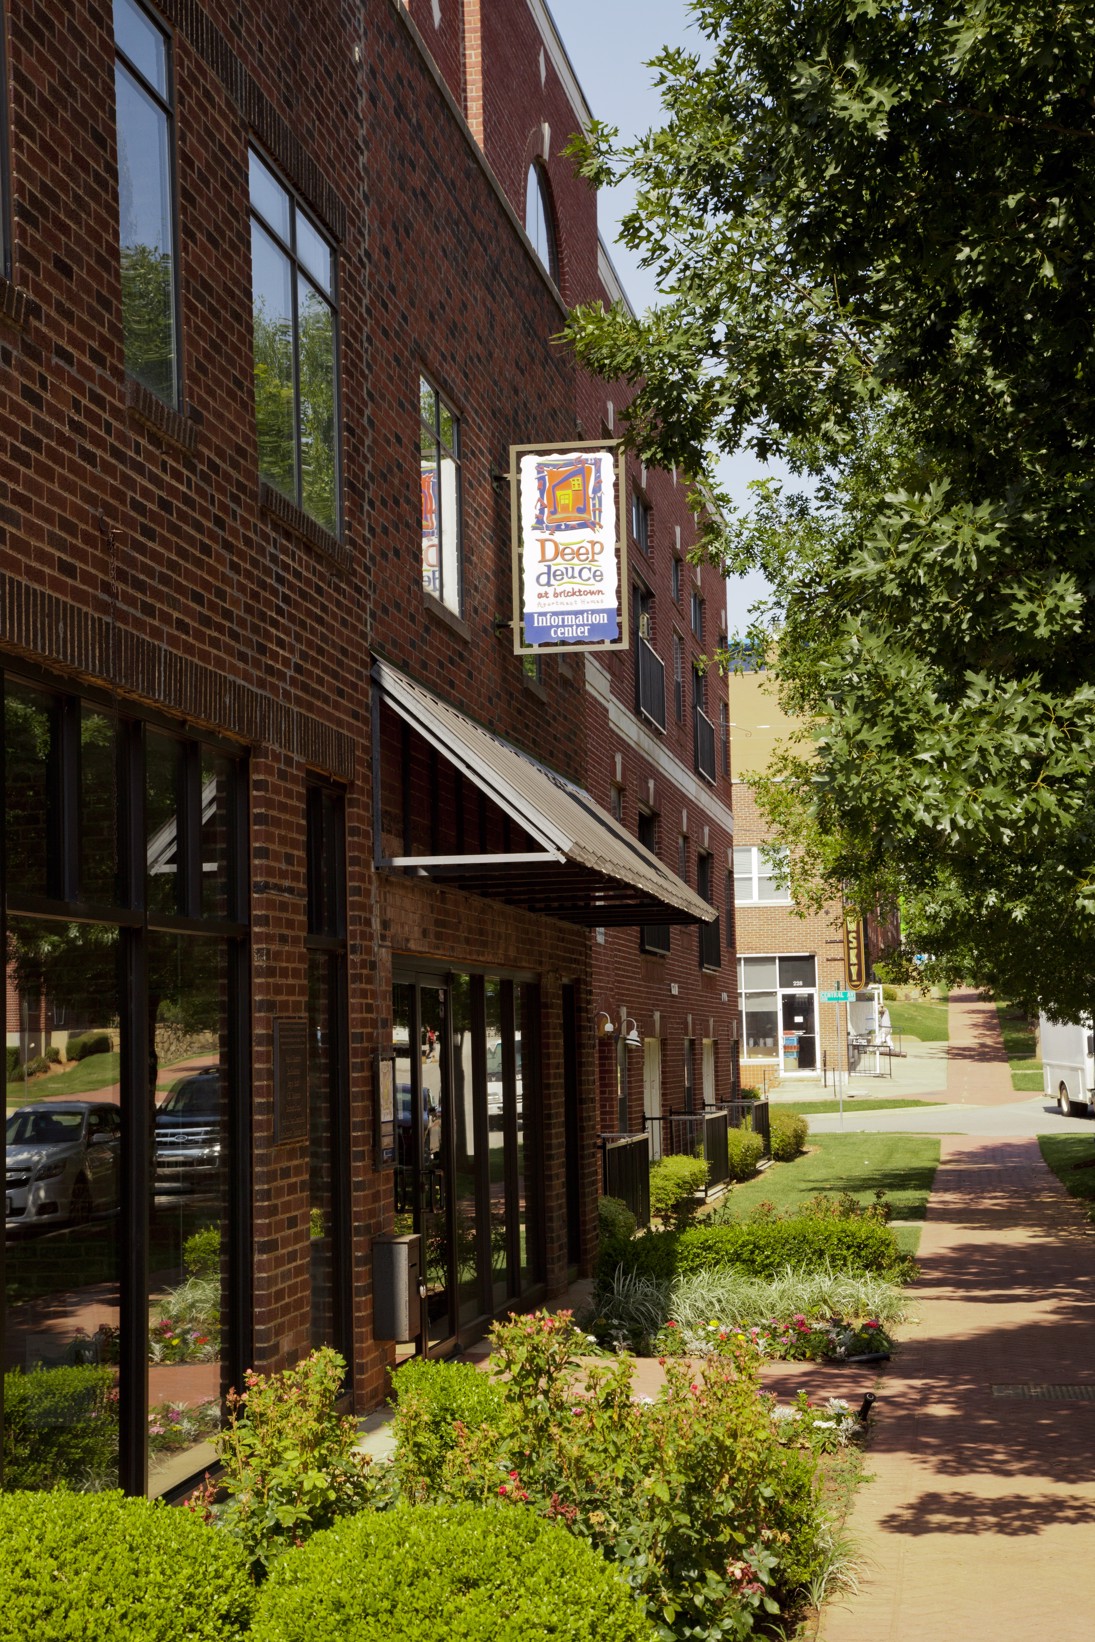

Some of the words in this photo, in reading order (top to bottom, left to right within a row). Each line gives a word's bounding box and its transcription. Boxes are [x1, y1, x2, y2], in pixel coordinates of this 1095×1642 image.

[535, 538, 604, 563] Deep
[535, 564, 604, 587] deuce
[537, 590, 550, 599] at
[553, 587, 605, 598] bricktown
[533, 611, 608, 627] Information
[550, 625, 590, 638] center
